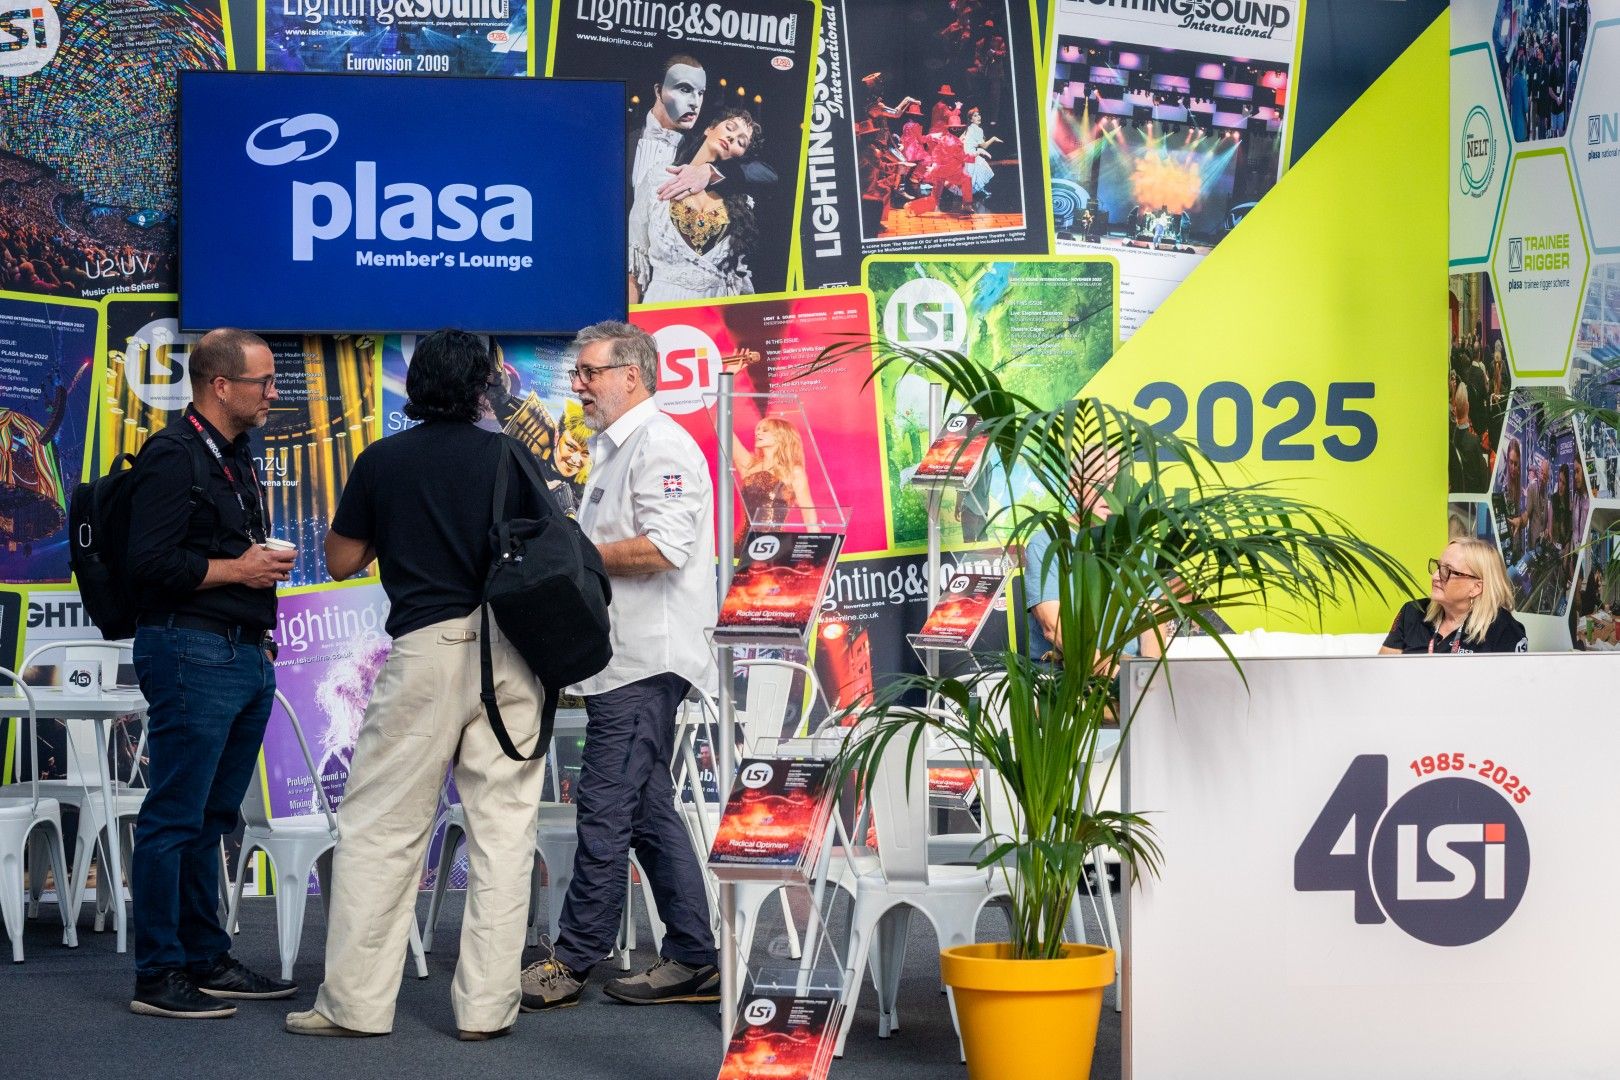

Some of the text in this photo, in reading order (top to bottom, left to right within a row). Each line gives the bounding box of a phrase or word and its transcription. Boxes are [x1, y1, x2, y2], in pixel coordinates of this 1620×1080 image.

[1178, 13, 1275, 39] International
[576, 33, 653, 48] www.lsionline.co.uk
[346, 53, 450, 72] Eurovision 2009
[1467, 139, 1489, 158] NELT
[1588, 148, 1617, 162] plasa national
[293, 161, 532, 261] plasa
[1525, 234, 1569, 250] TRAINEE
[356, 251, 532, 272] Member's Lounge
[1525, 253, 1569, 271] RIGGER
[82, 288, 105, 297] Music
[131, 283, 159, 292] Sphere
[1509, 279, 1570, 292] plasa trainee rigger scheme
[897, 303, 953, 342] LSi
[140, 344, 194, 384] LS
[950, 420, 964, 428] LSi
[1133, 380, 1378, 463] 2025
[753, 542, 776, 554] LSi
[952, 580, 967, 589] LSi
[762, 610, 796, 618] Optimism
[746, 769, 769, 782] LSi
[290, 799, 312, 810] Mixing
[729, 839, 789, 848] Radical Optimism
[1397, 823, 1506, 900] LSi
[749, 1006, 772, 1018] LSi
